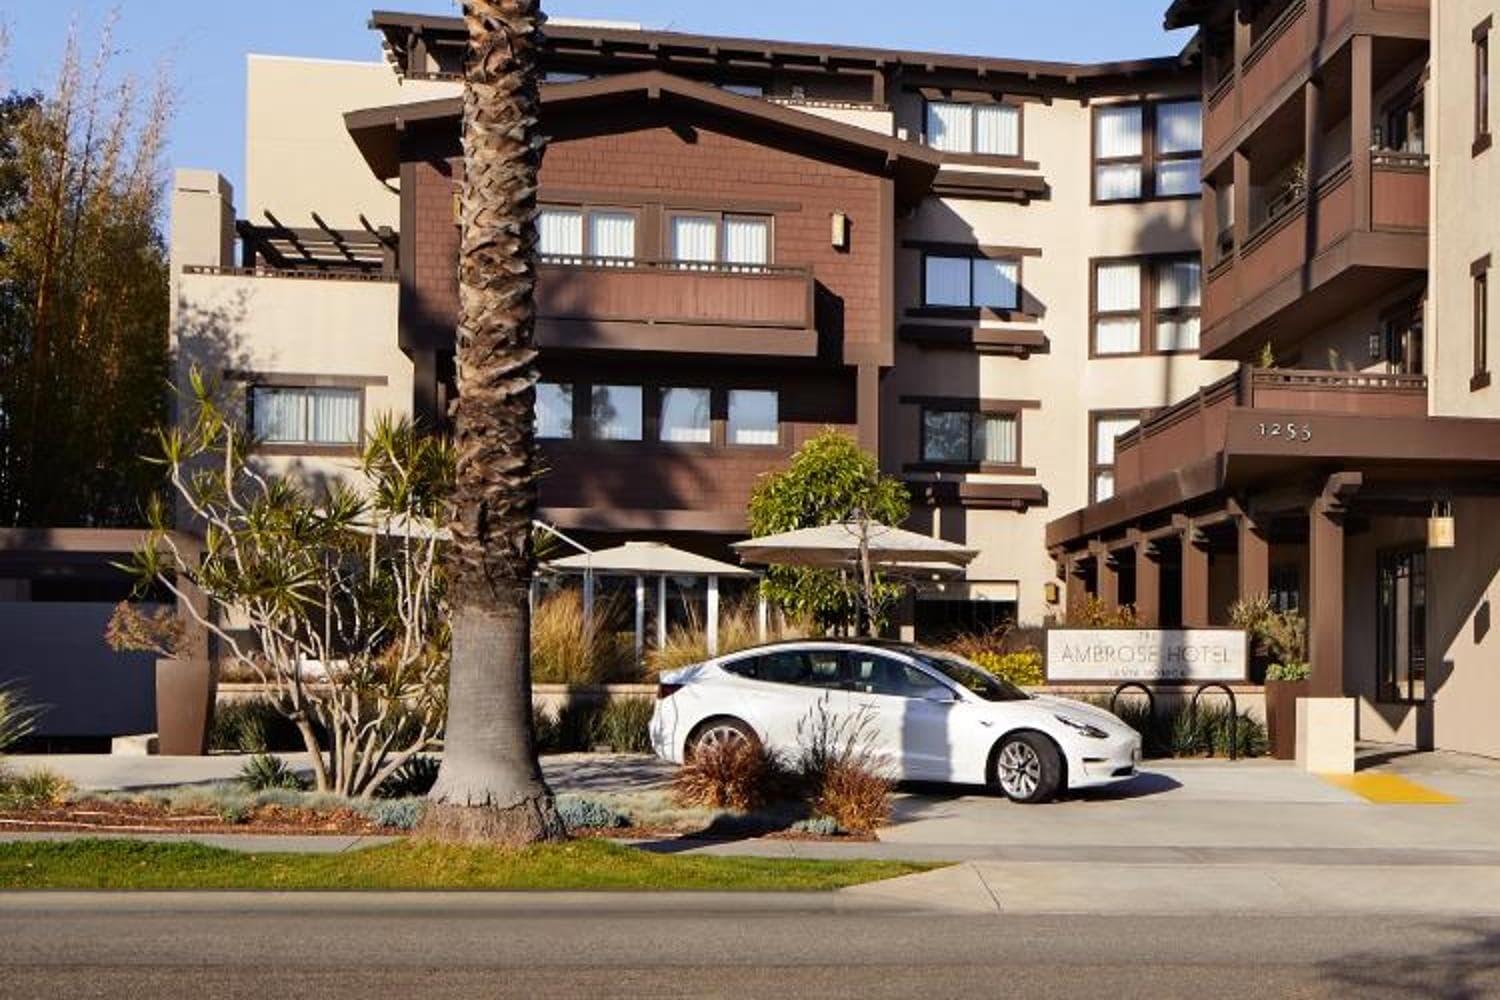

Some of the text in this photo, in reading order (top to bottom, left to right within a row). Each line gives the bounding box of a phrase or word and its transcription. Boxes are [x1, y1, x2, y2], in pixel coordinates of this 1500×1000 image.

[1259, 423, 1311, 441] 1255
[1061, 644, 1232, 663] AMBROSE HOTEL
